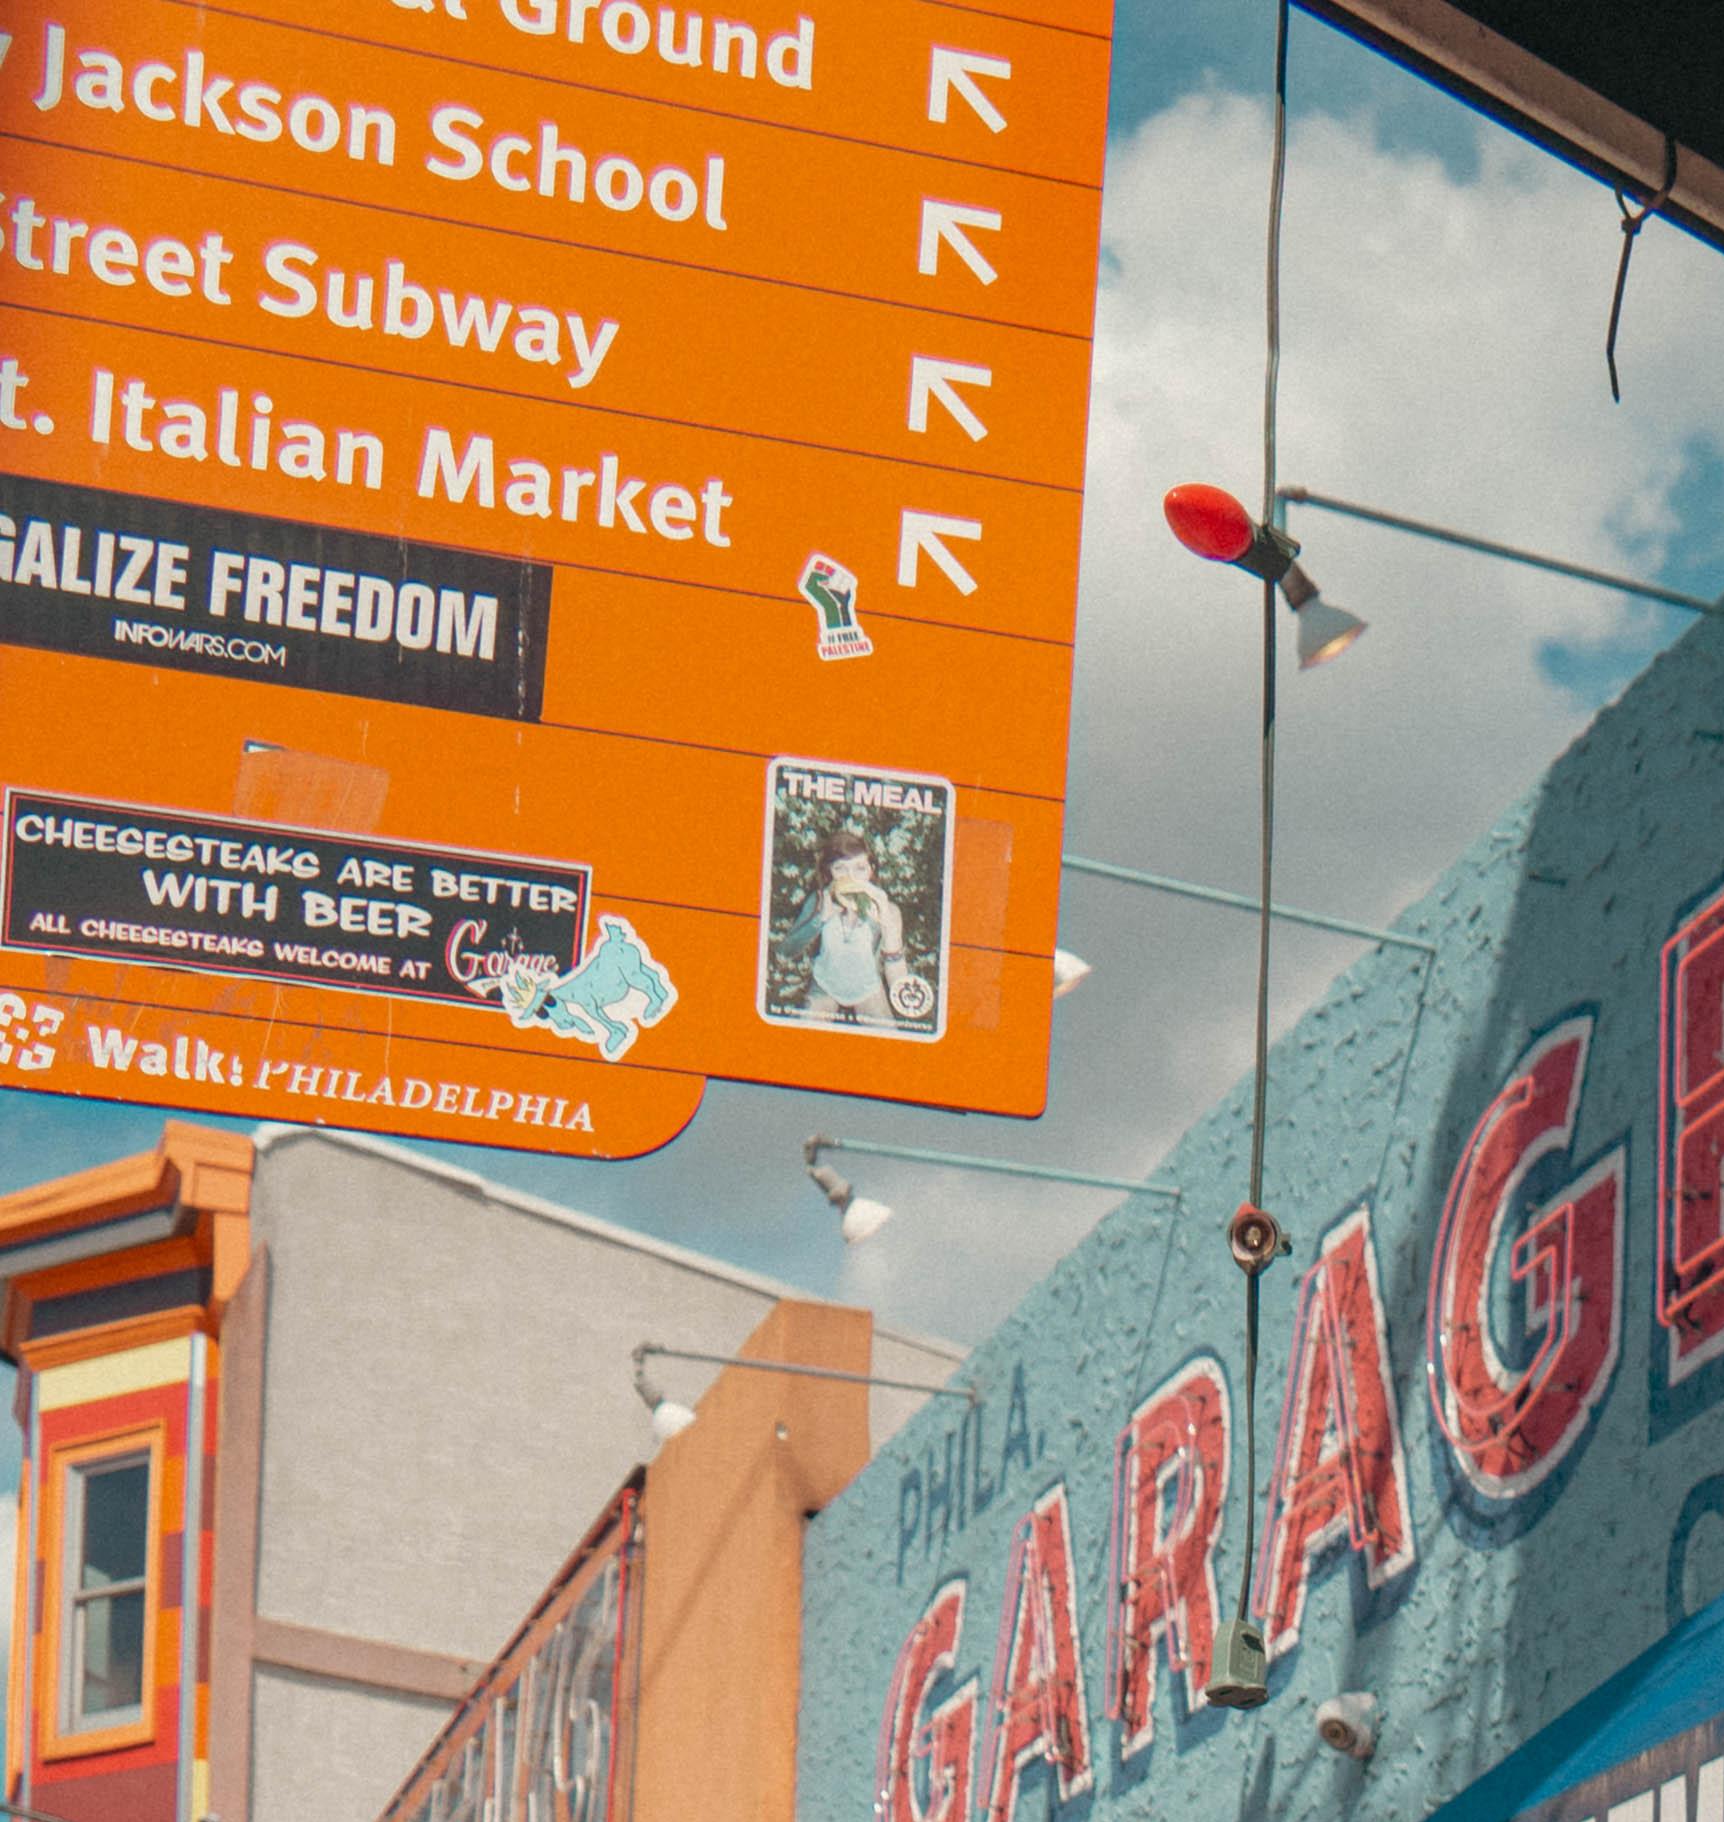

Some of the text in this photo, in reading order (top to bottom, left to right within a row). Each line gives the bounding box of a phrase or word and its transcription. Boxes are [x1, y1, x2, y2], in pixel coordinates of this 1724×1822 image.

[33, 23, 728, 231] Jackson School
[0, 194, 619, 388] treet Subway
[92, 371, 383, 490] Italian
[418, 428, 733, 547] Market
[114, 618, 286, 666] INFOWARS.COM
[209, 549, 498, 660] FREEDOM
[783, 772, 942, 815] THE MEAL
[15, 813, 578, 913] CHEESESTEAKS ARE BETTER
[142, 868, 433, 939] WITH BEER
[30, 912, 72, 934] ALL
[80, 918, 265, 958] CHEESESTEAKS
[273, 942, 391, 975] WELCOME
[400, 960, 432, 981] AT
[87, 1025, 595, 1132] Walk! PHILADELPHIA
